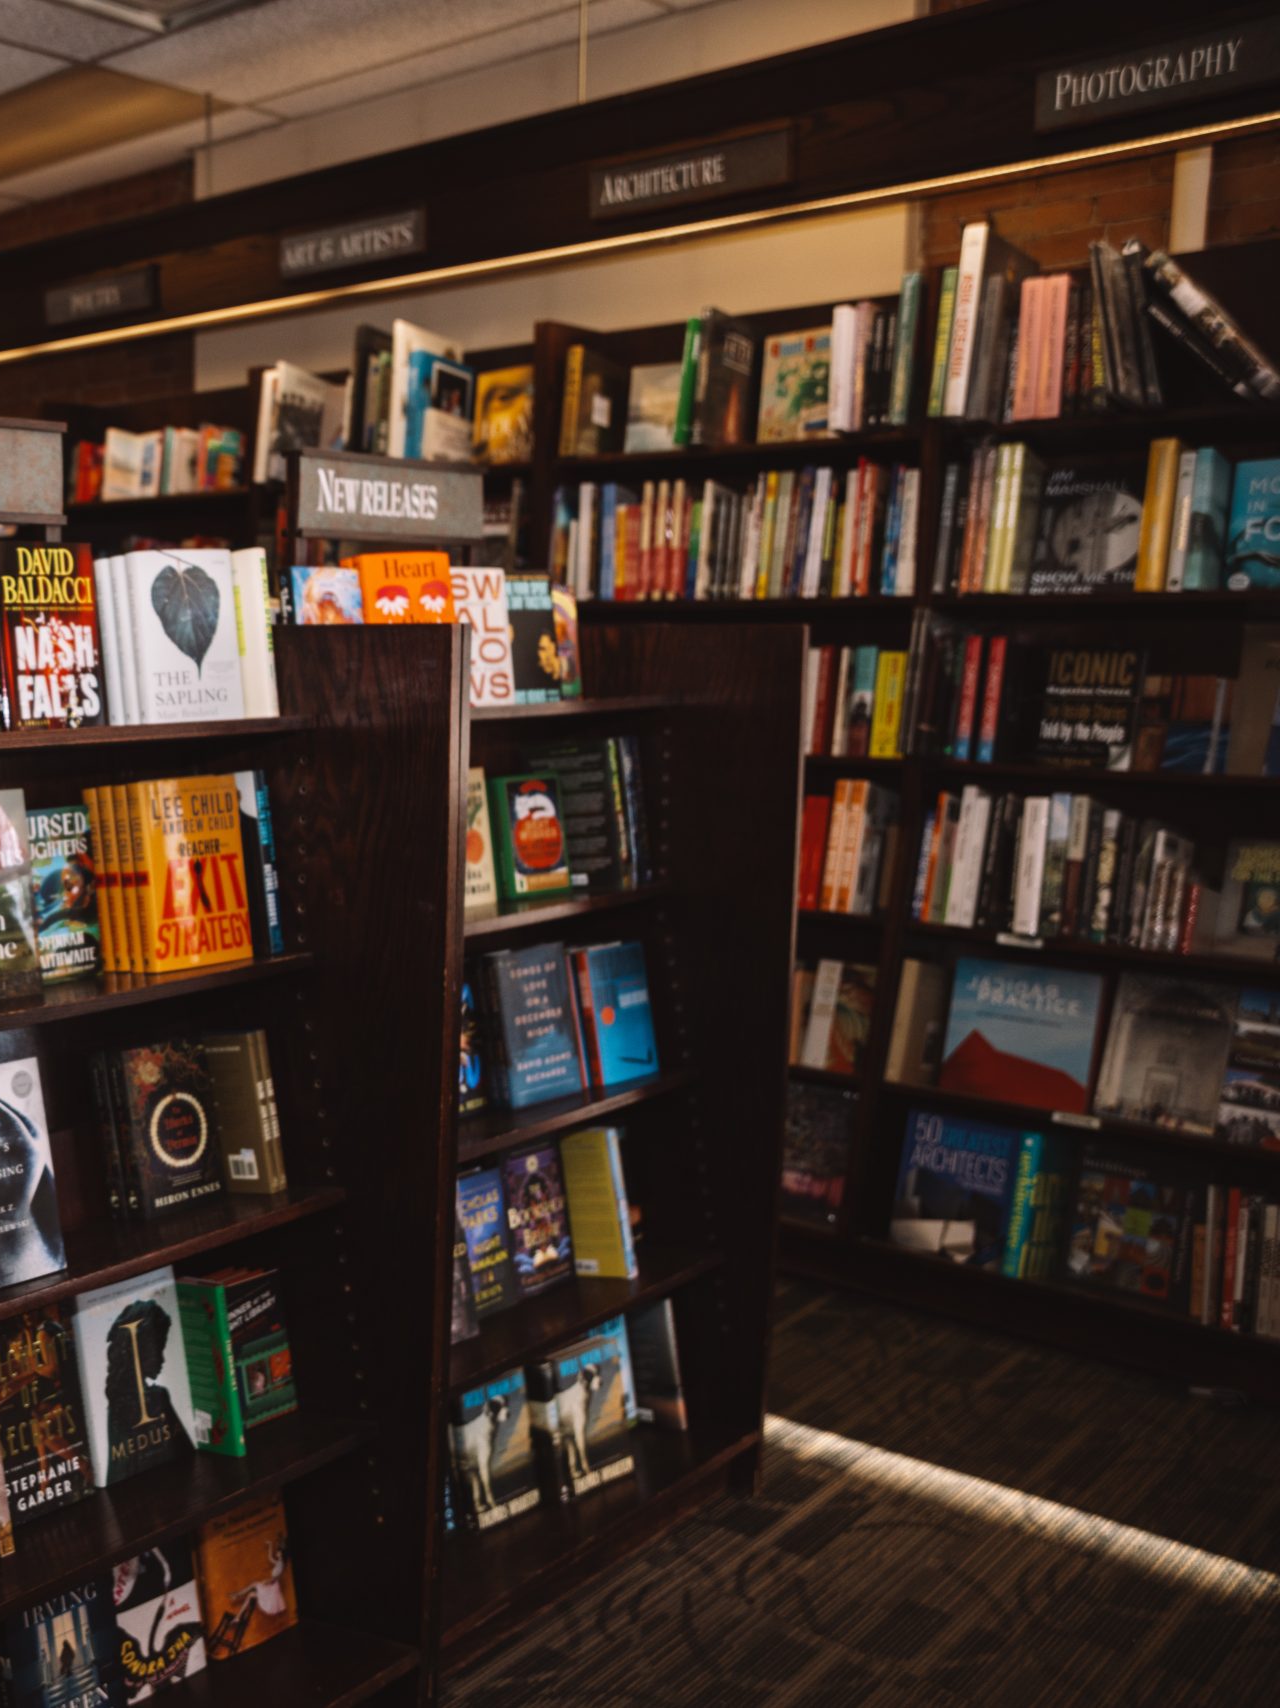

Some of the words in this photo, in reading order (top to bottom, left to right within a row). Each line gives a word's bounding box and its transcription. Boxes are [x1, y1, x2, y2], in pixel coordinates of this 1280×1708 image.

[1053, 37, 1243, 111] PHOTOGRAPHY
[600, 153, 726, 206] ARCHITECTURE
[361, 477, 439, 520] RELEASES
[16, 547, 76, 577] DAVID
[382, 559, 437, 579] Heart
[1, 575, 94, 605] BALDACCI
[15, 624, 96, 671] NASH
[1049, 650, 1138, 687] ICONIC
[17, 673, 101, 720] FALLS
[152, 670, 193, 687] THE
[155, 687, 229, 706] SAPLING
[151, 795, 184, 821] LEE
[191, 790, 234, 816] CHILD
[162, 817, 204, 835] ANDREW
[208, 814, 235, 832] CHILD
[162, 852, 247, 920] EXIT
[155, 910, 253, 962] STRATEGY
[913, 1113, 945, 1145] 50
[908, 1142, 1011, 1187] ARCHITECTS
[4, 1455, 81, 1498] STEPHANIE
[16, 1479, 73, 1512] GARBER
[23, 1581, 97, 1630] IRVING
[120, 1639, 167, 1678] SONORA
[167, 1630, 192, 1661] JHA
